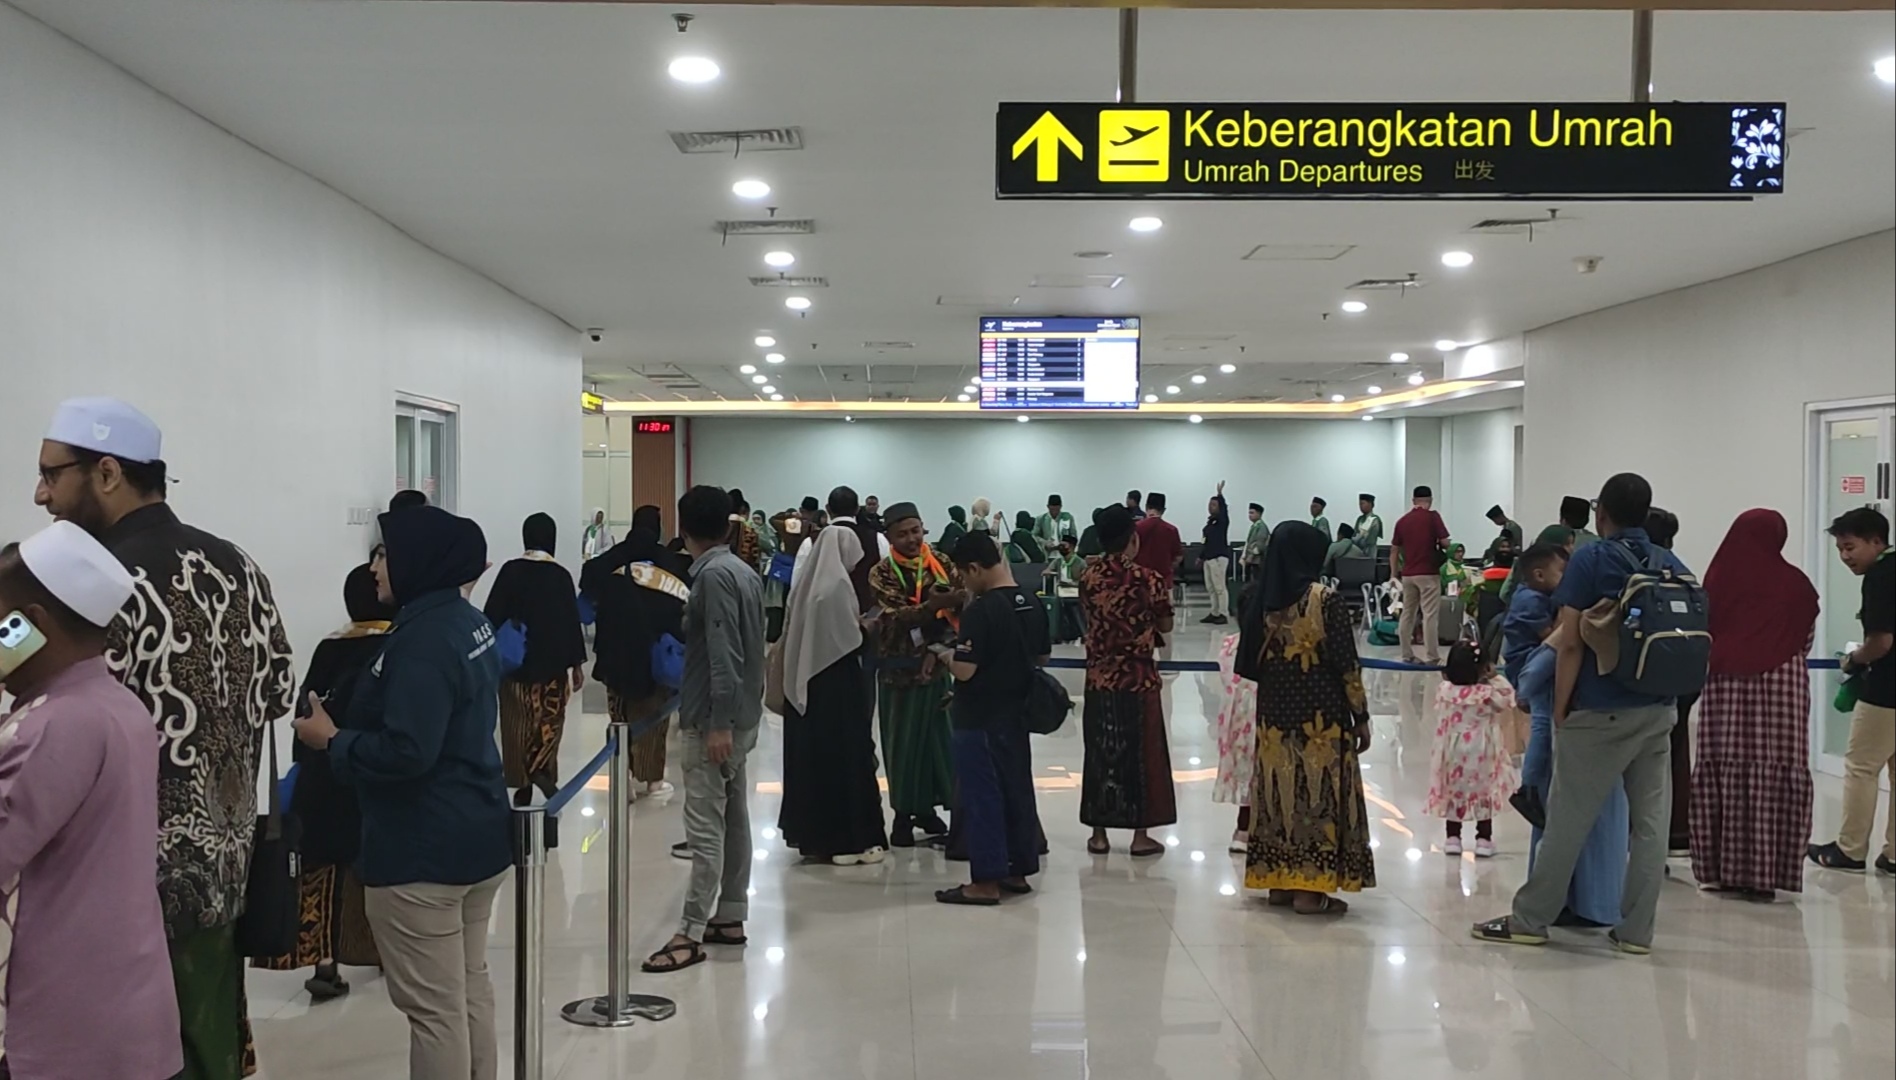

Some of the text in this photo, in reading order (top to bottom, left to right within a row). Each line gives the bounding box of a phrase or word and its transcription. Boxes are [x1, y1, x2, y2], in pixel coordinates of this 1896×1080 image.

[1184, 109, 1672, 157] Keberangkatan Umrah
[1184, 159, 1423, 188] Umrah Departures
[1454, 159, 1496, 181] 出发
